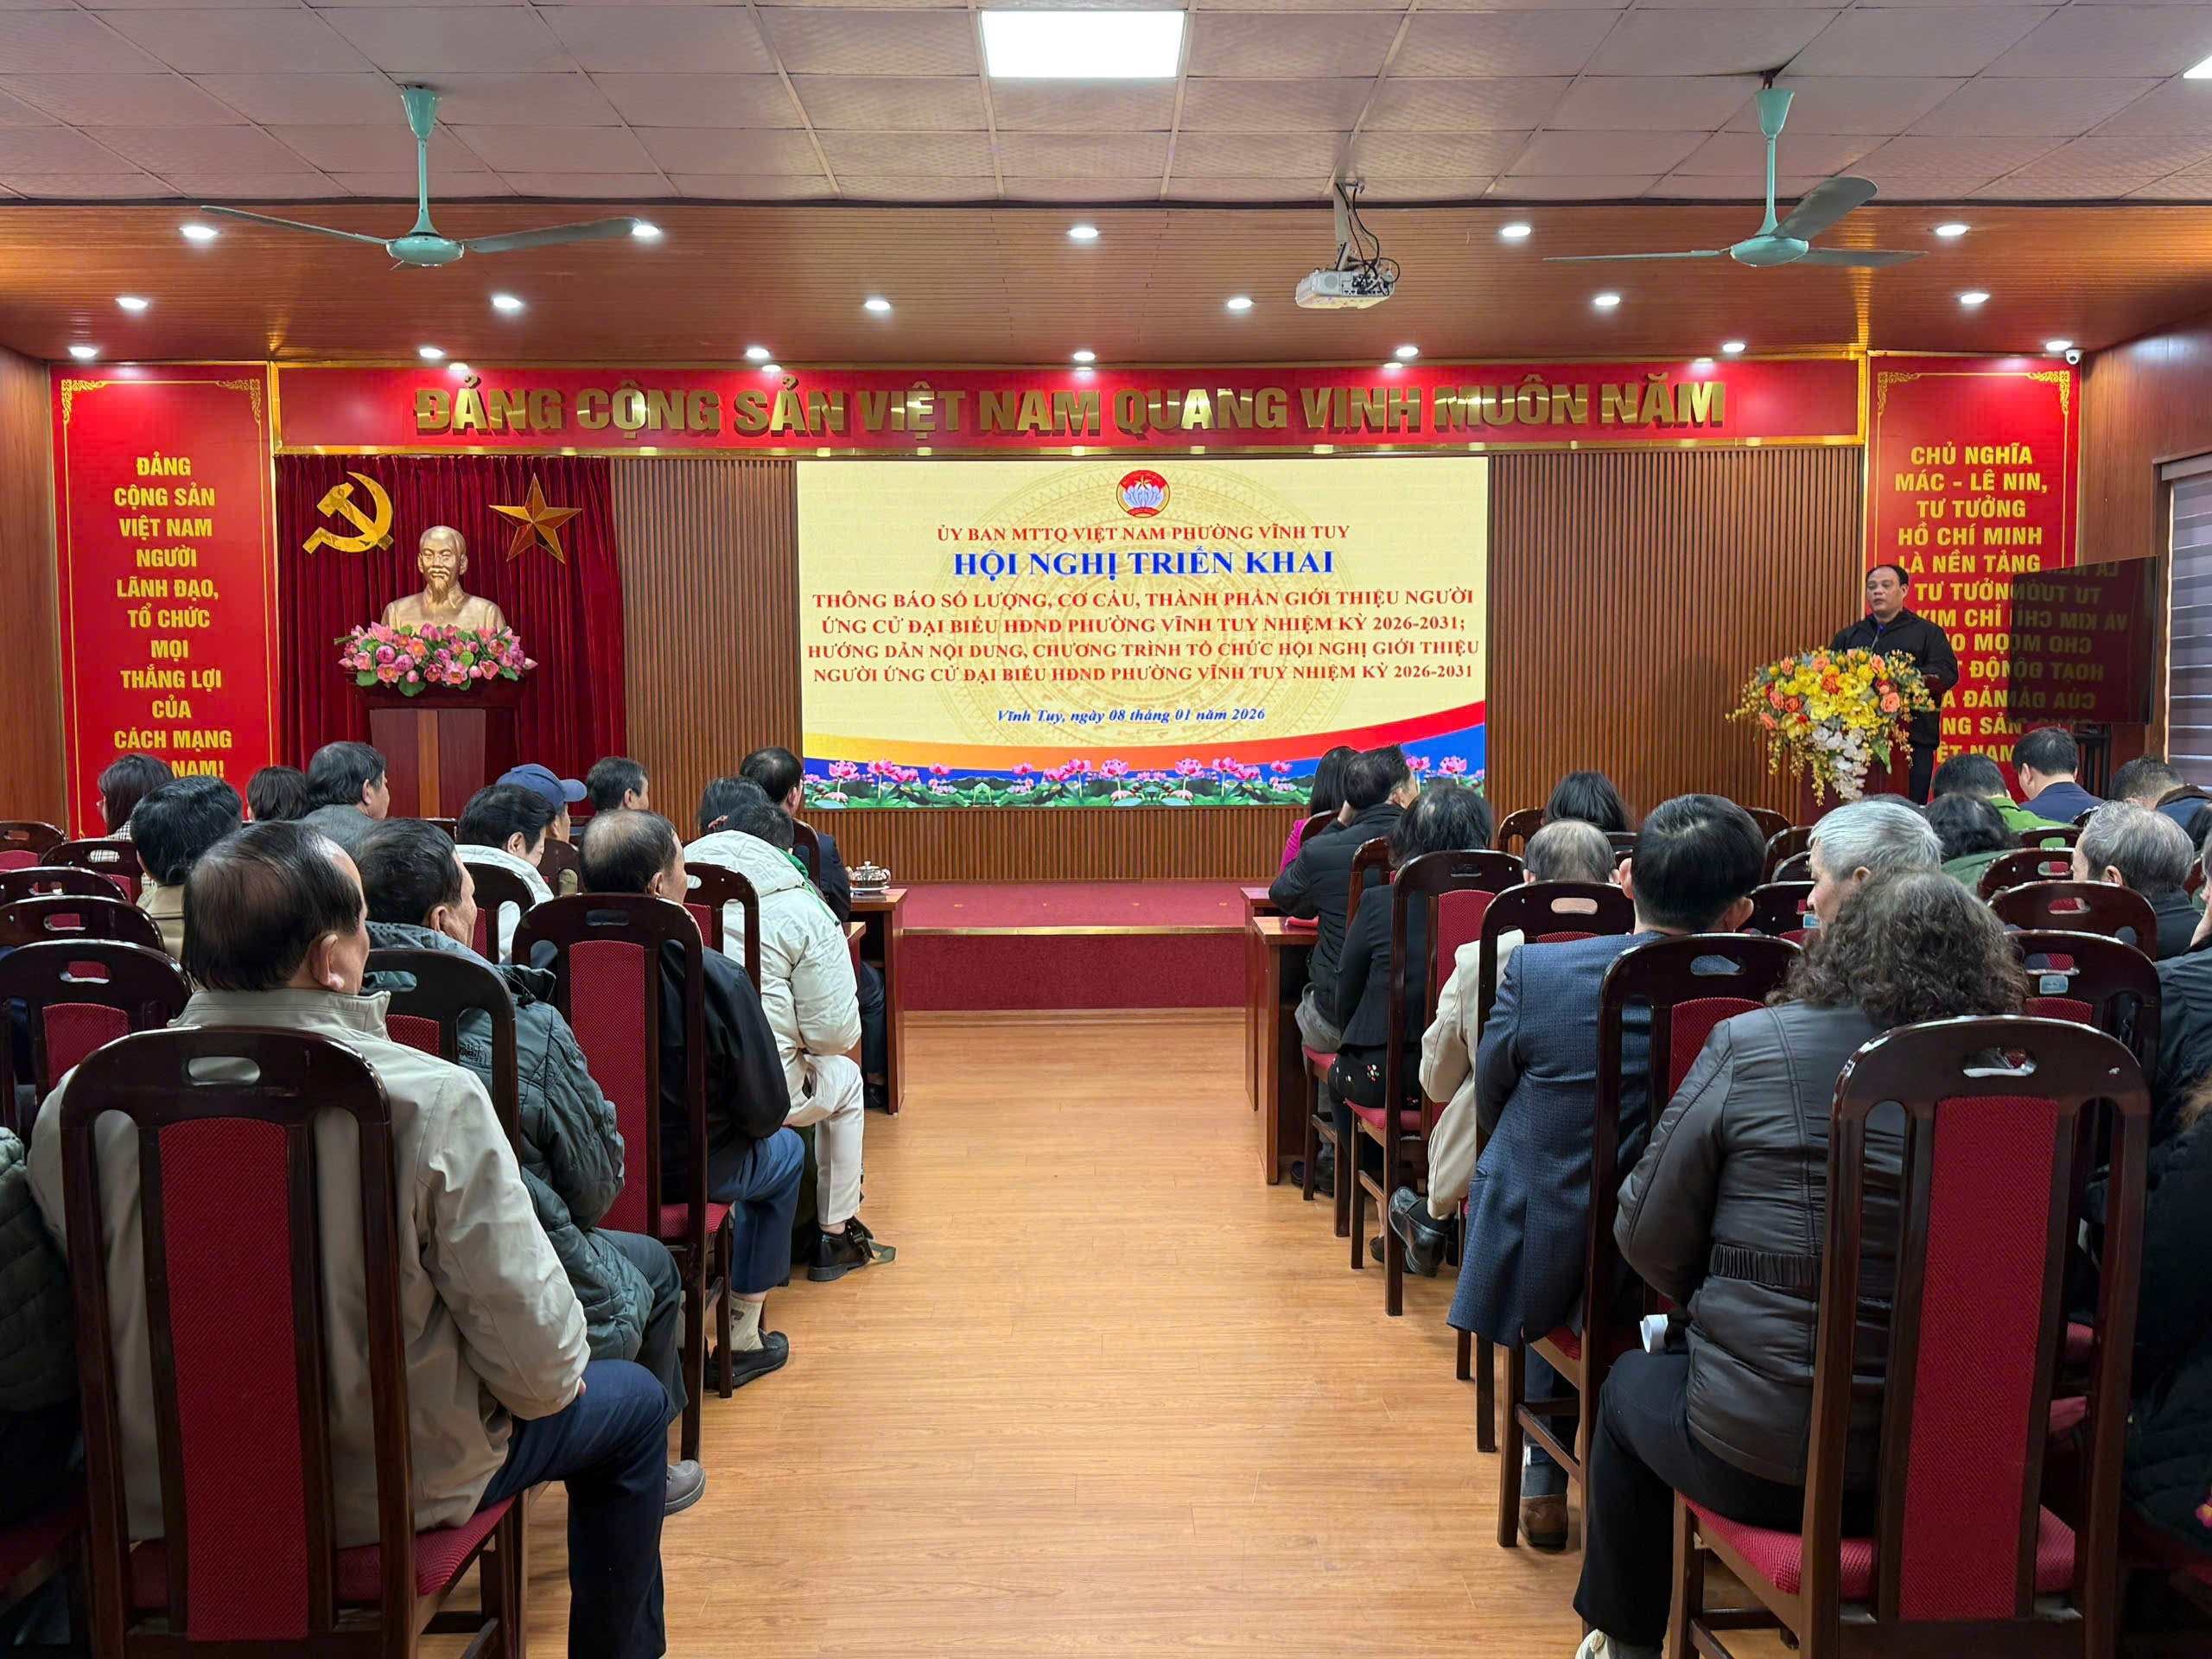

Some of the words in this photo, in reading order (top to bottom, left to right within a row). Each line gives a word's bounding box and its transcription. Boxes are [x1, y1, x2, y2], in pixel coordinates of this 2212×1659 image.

[415, 375, 563, 435] ĐẢNG
[575, 380, 721, 440] CỘNG
[734, 376, 849, 435] SẢN
[856, 381, 967, 440] VIỆT
[981, 389, 1099, 436] NAM
[1115, 388, 1287, 436] QUANG
[1300, 387, 1422, 435] VINH
[1433, 375, 1590, 431] MUÔN
[1601, 372, 1726, 431] NĂM
[137, 451, 191, 476] ĐẢNG
[1911, 442, 1955, 465] CHỦ
[1965, 442, 2032, 464] NGHĨA
[1895, 468, 1945, 492] MÁC
[1971, 469, 1994, 491] LÊ
[2004, 473, 2047, 493] NIN,
[114, 484, 168, 510] CỘNG
[175, 482, 214, 506] SẢN
[1916, 499, 1946, 518] TƯ
[1952, 495, 2025, 518] TƯỞNG
[119, 515, 160, 540] VIỆT
[167, 518, 212, 537] NAM
[938, 526, 963, 541] ỦY
[969, 528, 1006, 542] BAN
[1012, 528, 1068, 543] MTTQ
[1073, 526, 1118, 543] VIỆT
[1122, 526, 1165, 541] NAM
[1173, 524, 1253, 542] PHƯỜNG
[1259, 524, 1306, 539] VĨNH
[1312, 525, 1349, 539] TUY
[1898, 521, 1929, 546] HỒ
[1937, 524, 1975, 545] CHÍ
[1984, 527, 2042, 544] MINH
[137, 544, 196, 567] NGƯỜI
[955, 550, 1016, 582] HỘI
[1030, 553, 1116, 581] NGHỊ
[1247, 550, 1332, 574] KHAI
[1899, 551, 1924, 573] LÀ
[1933, 550, 1975, 573] NỀN
[1984, 550, 2040, 572] TẢNG
[118, 576, 168, 597] LÃNH
[174, 580, 219, 601] ĐẠO,
[812, 590, 887, 608] THÔNG
[894, 591, 936, 608] BÁO
[975, 593, 1052, 611] LƯỢNG,
[1058, 593, 1087, 608] CƠ
[1146, 590, 1218, 607] THÀNH
[1284, 588, 1330, 606] GIỚI
[1336, 589, 1398, 608] THIỆU
[1405, 587, 1473, 604] NGƯỜI
[1915, 582, 1943, 601] TƯ
[1950, 578, 2012, 601] TƯỞN
[128, 603, 151, 627] TỔ
[158, 607, 210, 627] CHỨC
[822, 617, 866, 634] ỨNG
[908, 620, 944, 637] ĐẠI
[1004, 620, 1063, 633] HĐND
[1069, 615, 1155, 633] PHƯỜNG
[1161, 615, 1211, 632] VĨNH
[1217, 617, 1258, 632] TUY
[1264, 616, 1332, 634] NHIỆM
[1372, 616, 1465, 631] 2026-2031;
[1964, 603, 2001, 627] CHỈ
[151, 640, 188, 662] MỌI
[809, 643, 878, 658] HƯỚNG
[930, 643, 963, 660] NỘI
[969, 645, 1028, 659] DUNG,
[1033, 643, 1116, 658] CHƯƠNG
[1122, 641, 1180, 657] TRÌNH
[1217, 640, 1273, 657] CHỨC
[1279, 640, 1313, 658] HỘI
[1319, 642, 1366, 658] NGHỊ
[1372, 639, 1414, 655] GIỚI
[1420, 640, 1478, 657] THIỆU
[121, 664, 185, 688] THẮNG
[192, 669, 221, 691] LỢI
[814, 665, 877, 682] NGƯỜI
[884, 664, 925, 682] ỨNG
[963, 668, 996, 684] ĐẠI
[1052, 667, 1105, 682] HĐND
[1111, 663, 1192, 681] PHƯỜNG
[1198, 664, 1244, 681] VĨNH
[1249, 666, 1287, 679] TUY
[1293, 664, 1356, 682] NHIỆM
[1394, 665, 1471, 677] 2026-2031
[1969, 656, 2010, 682] ĐỘN
[152, 695, 191, 718] CỦA
[1963, 685, 2007, 708] ĐẢN
[999, 710, 1031, 721] Vĩnh
[1039, 710, 1065, 724] Tuy,
[1071, 711, 1103, 724] ngày
[1109, 709, 1127, 721] 08
[1130, 709, 1171, 724] tháng
[1175, 709, 1191, 721] 01
[1196, 709, 1227, 721] năm
[1232, 708, 1265, 721] 2026
[1980, 712, 2021, 734] SẢN
[115, 728, 166, 748] CÁCH
[174, 730, 232, 752] MẠNG
[172, 760, 224, 779] NAM!
